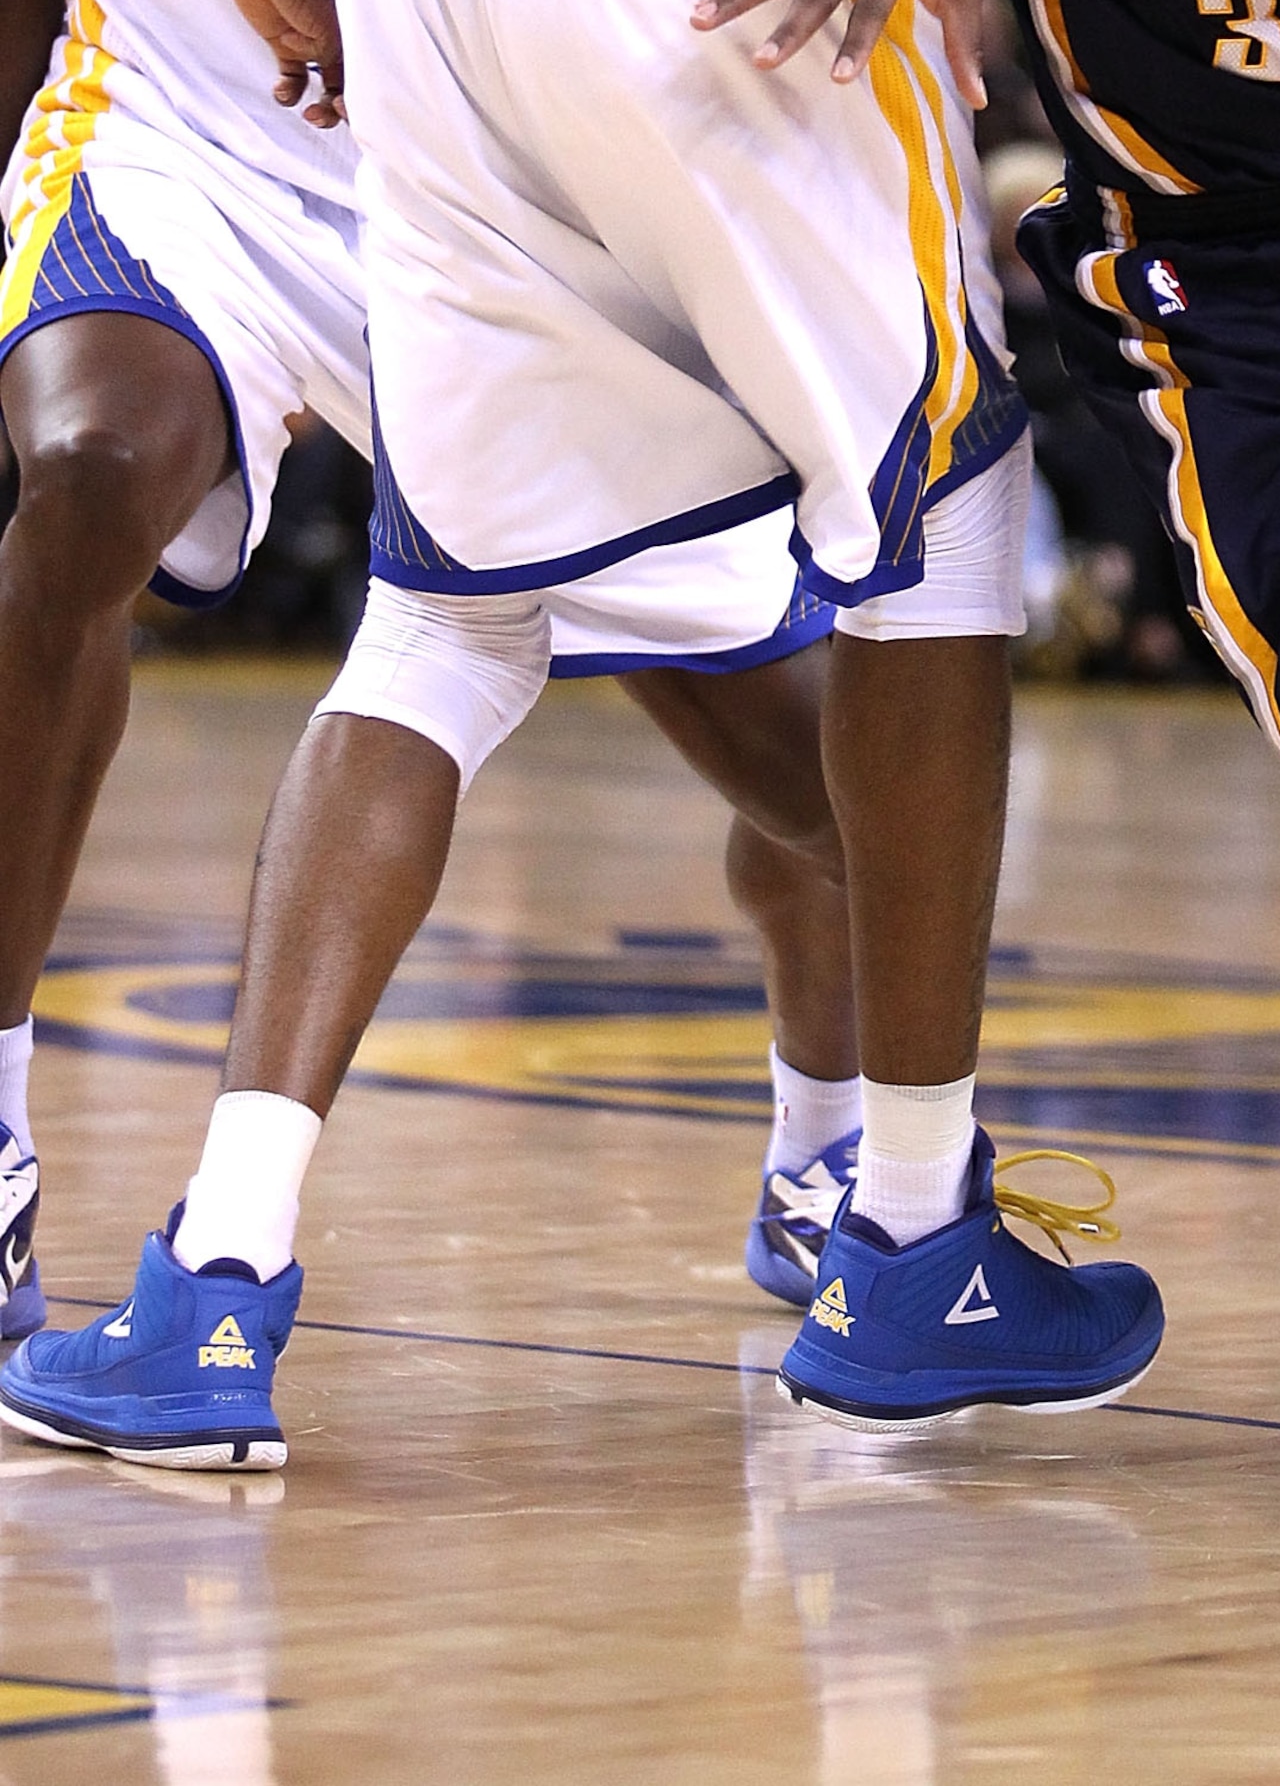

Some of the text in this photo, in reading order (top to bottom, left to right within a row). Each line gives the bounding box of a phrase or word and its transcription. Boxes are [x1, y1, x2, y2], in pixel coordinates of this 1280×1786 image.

[1158, 302, 1180, 315] NBA
[809, 1298, 855, 1337] PEAK
[199, 1346, 256, 1369] PEAK
